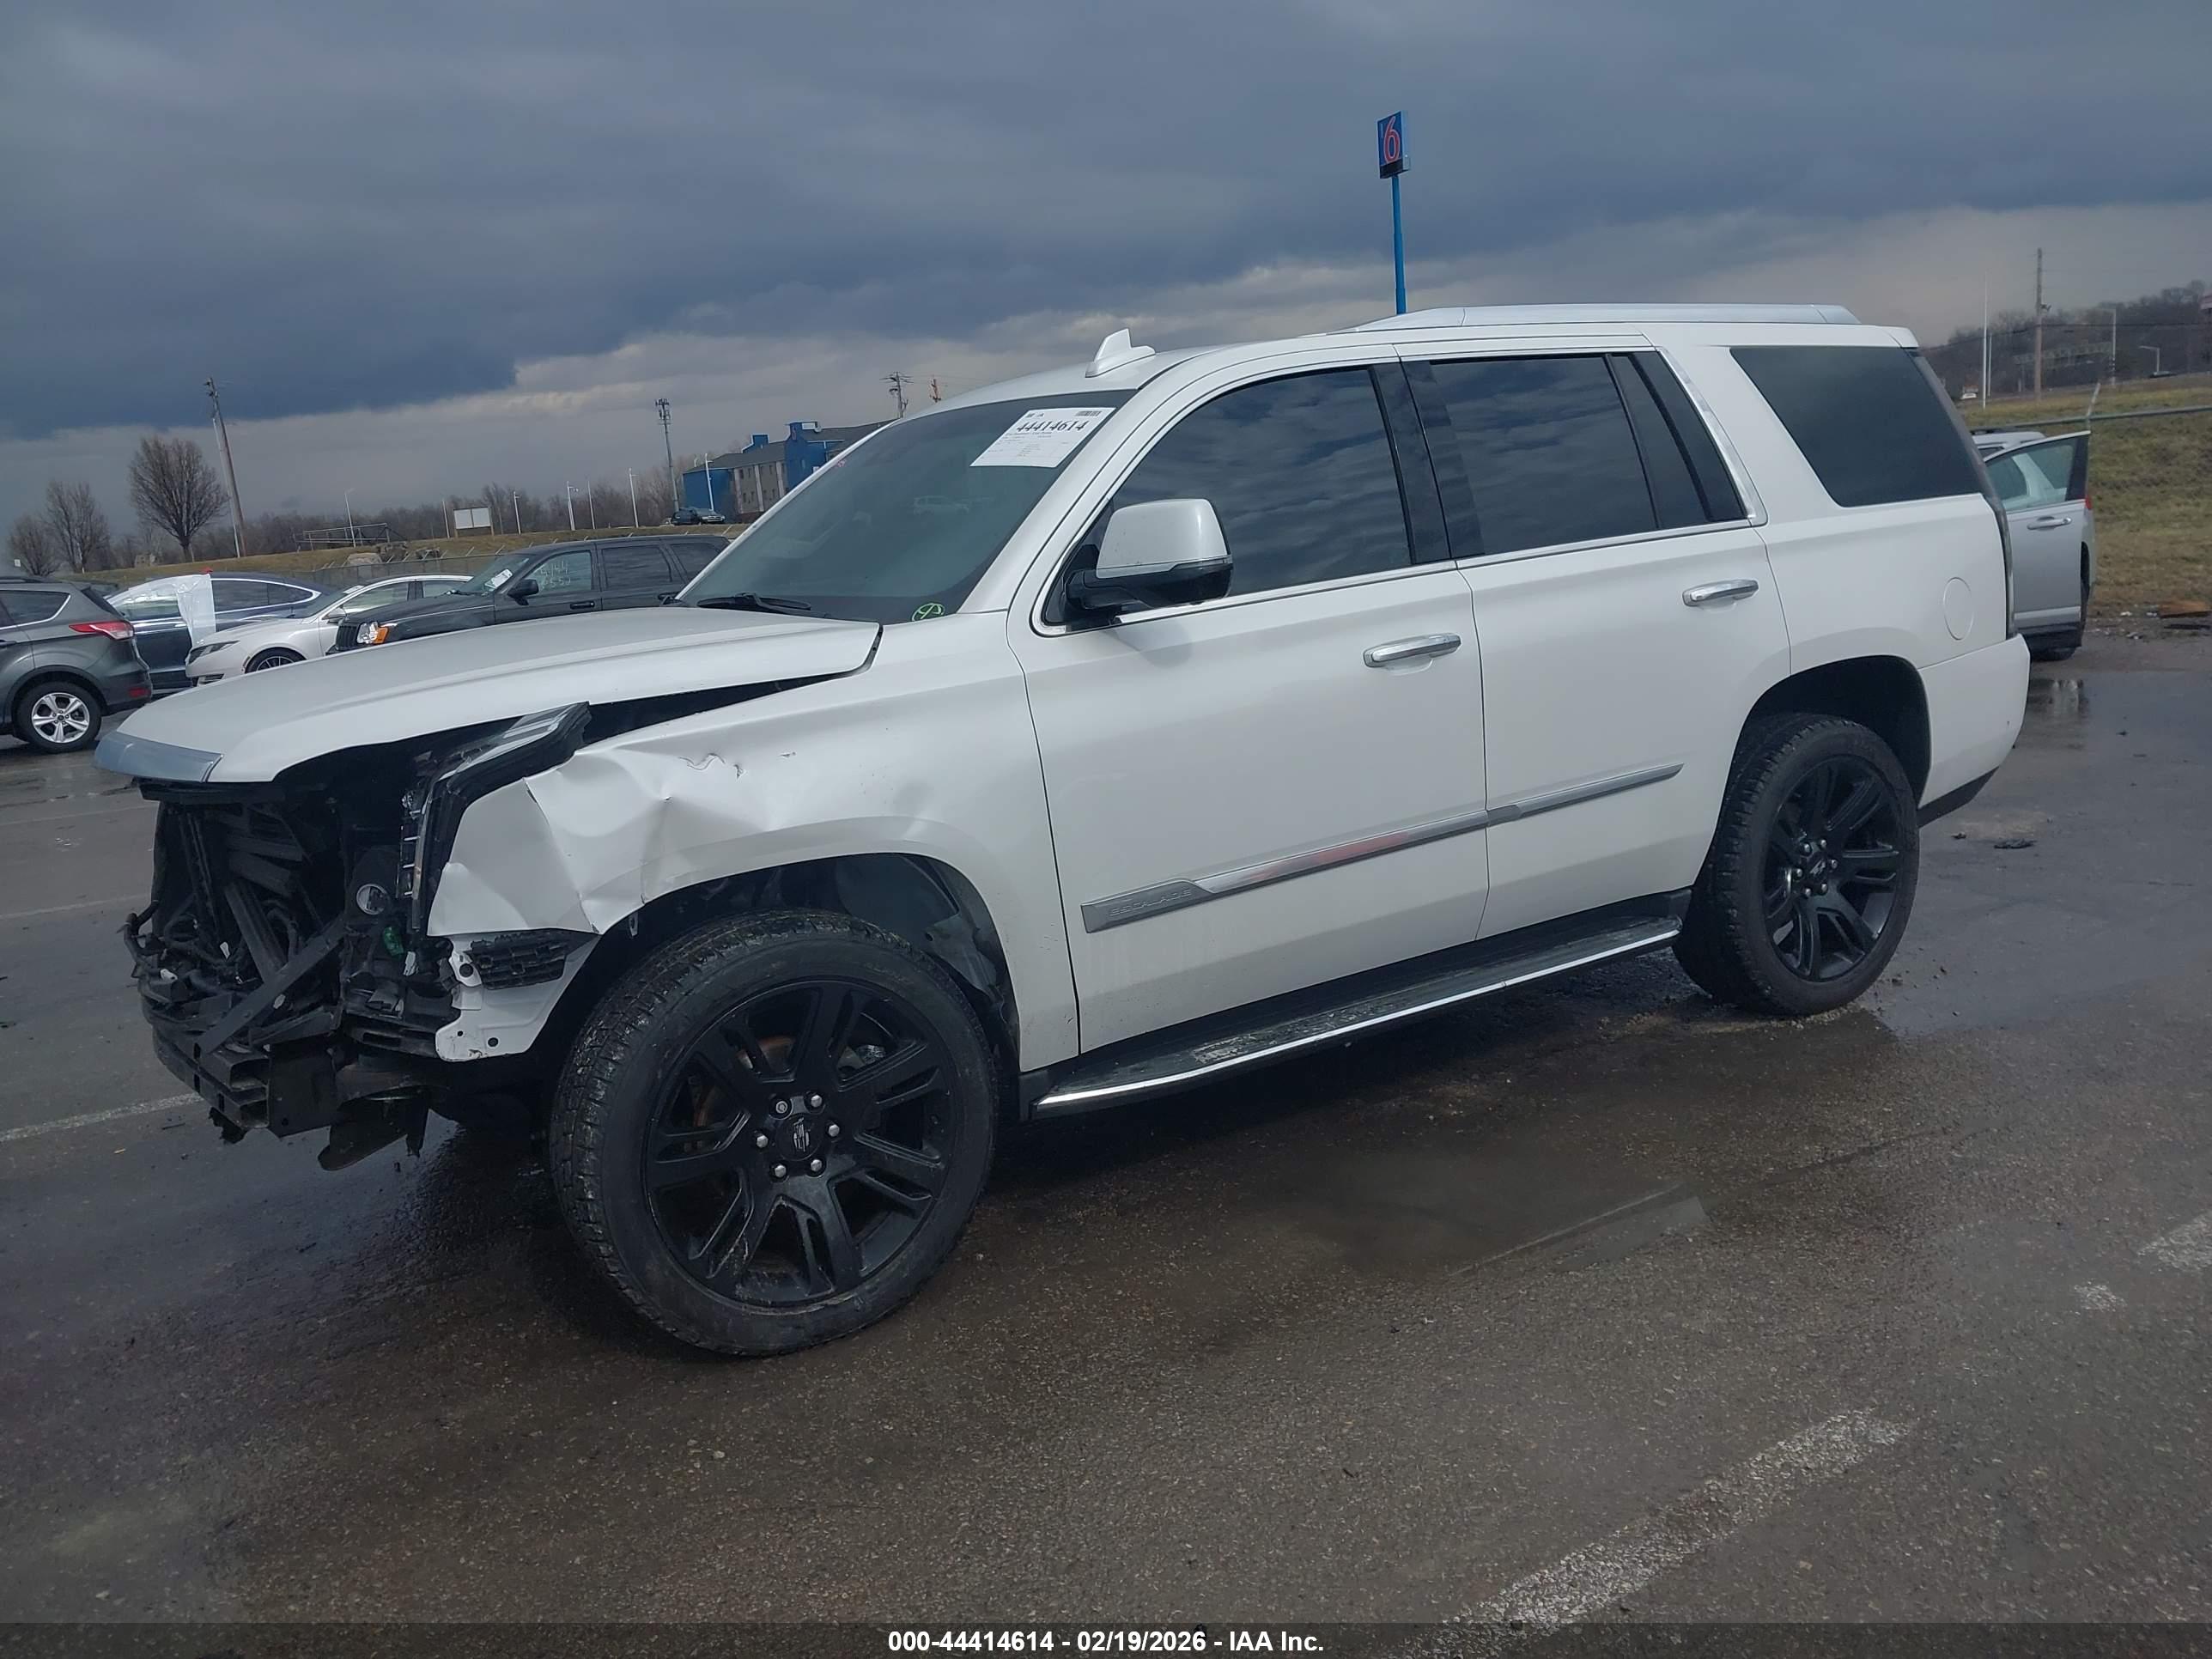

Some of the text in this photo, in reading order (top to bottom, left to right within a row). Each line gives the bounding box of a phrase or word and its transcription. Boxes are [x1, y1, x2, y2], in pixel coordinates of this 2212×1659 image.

[1383, 115, 1401, 163] 6
[1017, 420, 1090, 433] 44414614
[1109, 888, 1193, 917] ESCALADE
